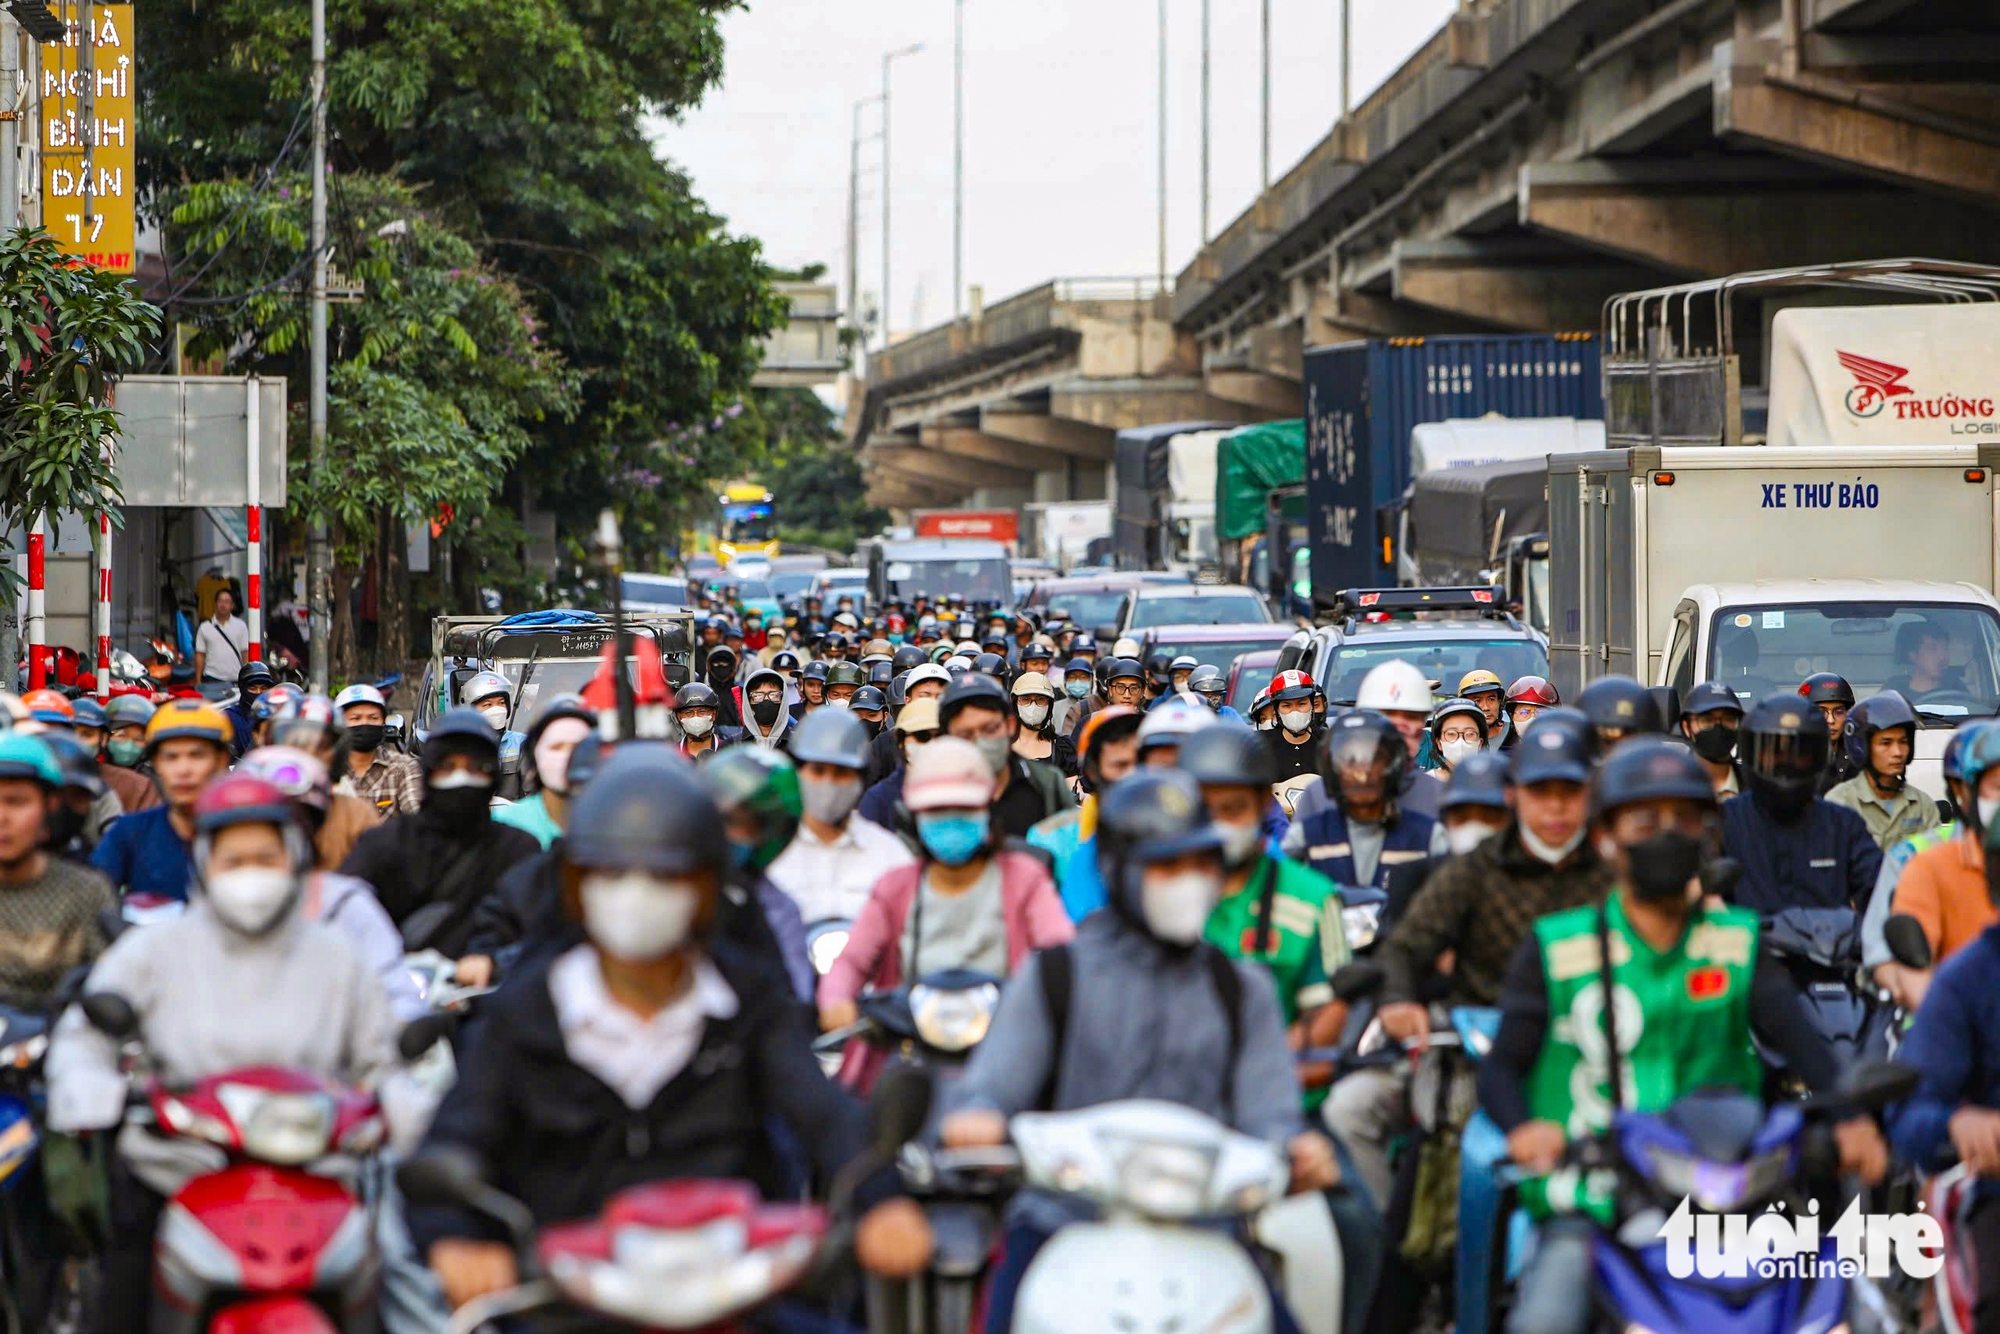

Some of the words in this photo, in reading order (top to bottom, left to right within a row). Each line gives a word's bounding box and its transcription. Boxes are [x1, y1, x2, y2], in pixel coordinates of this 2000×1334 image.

[1893, 392, 1995, 419] TRƯỜNG
[1761, 483, 1787, 508] XE
[1793, 481, 1834, 508] THƯ
[1838, 476, 1879, 508] BÁO
